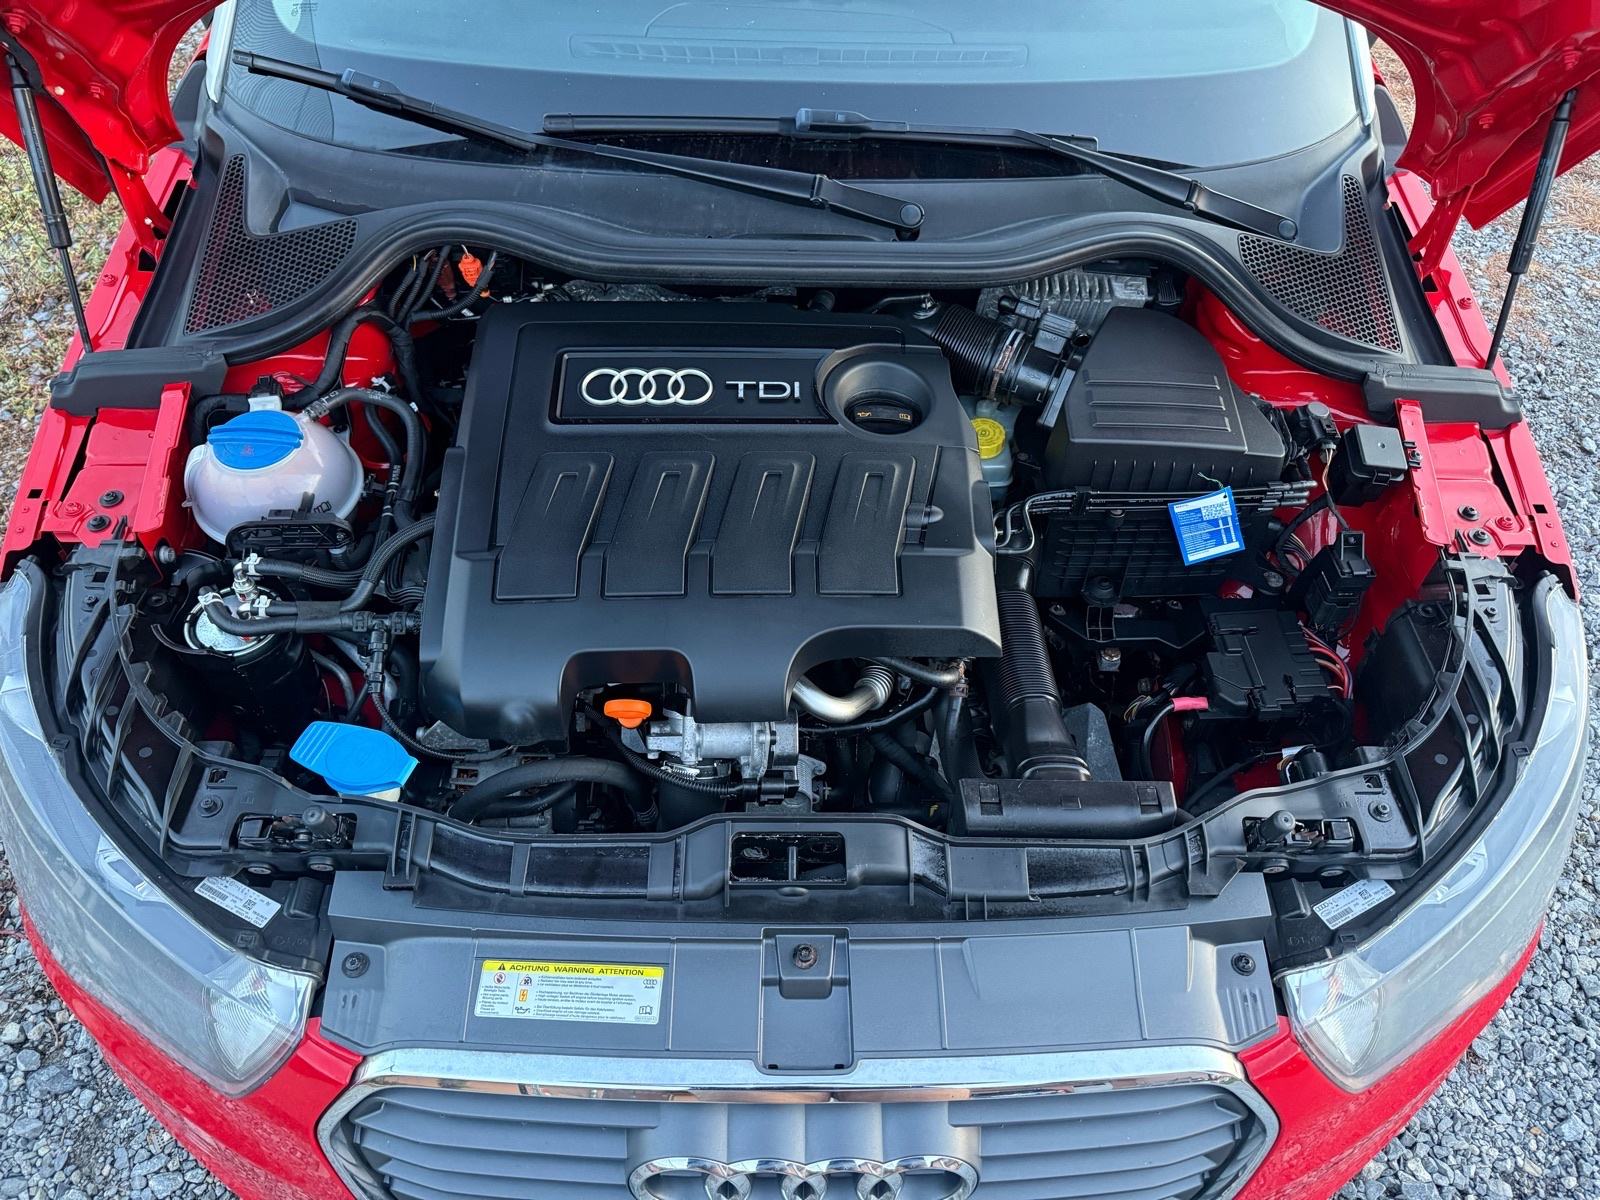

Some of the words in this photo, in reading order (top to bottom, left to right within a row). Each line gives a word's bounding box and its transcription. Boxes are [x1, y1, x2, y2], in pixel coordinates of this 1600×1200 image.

[726, 381, 801, 401] TDI
[509, 964, 550, 973] ACHTUNG
[554, 965, 595, 974] WARNING
[599, 967, 645, 976] ATTENTION
